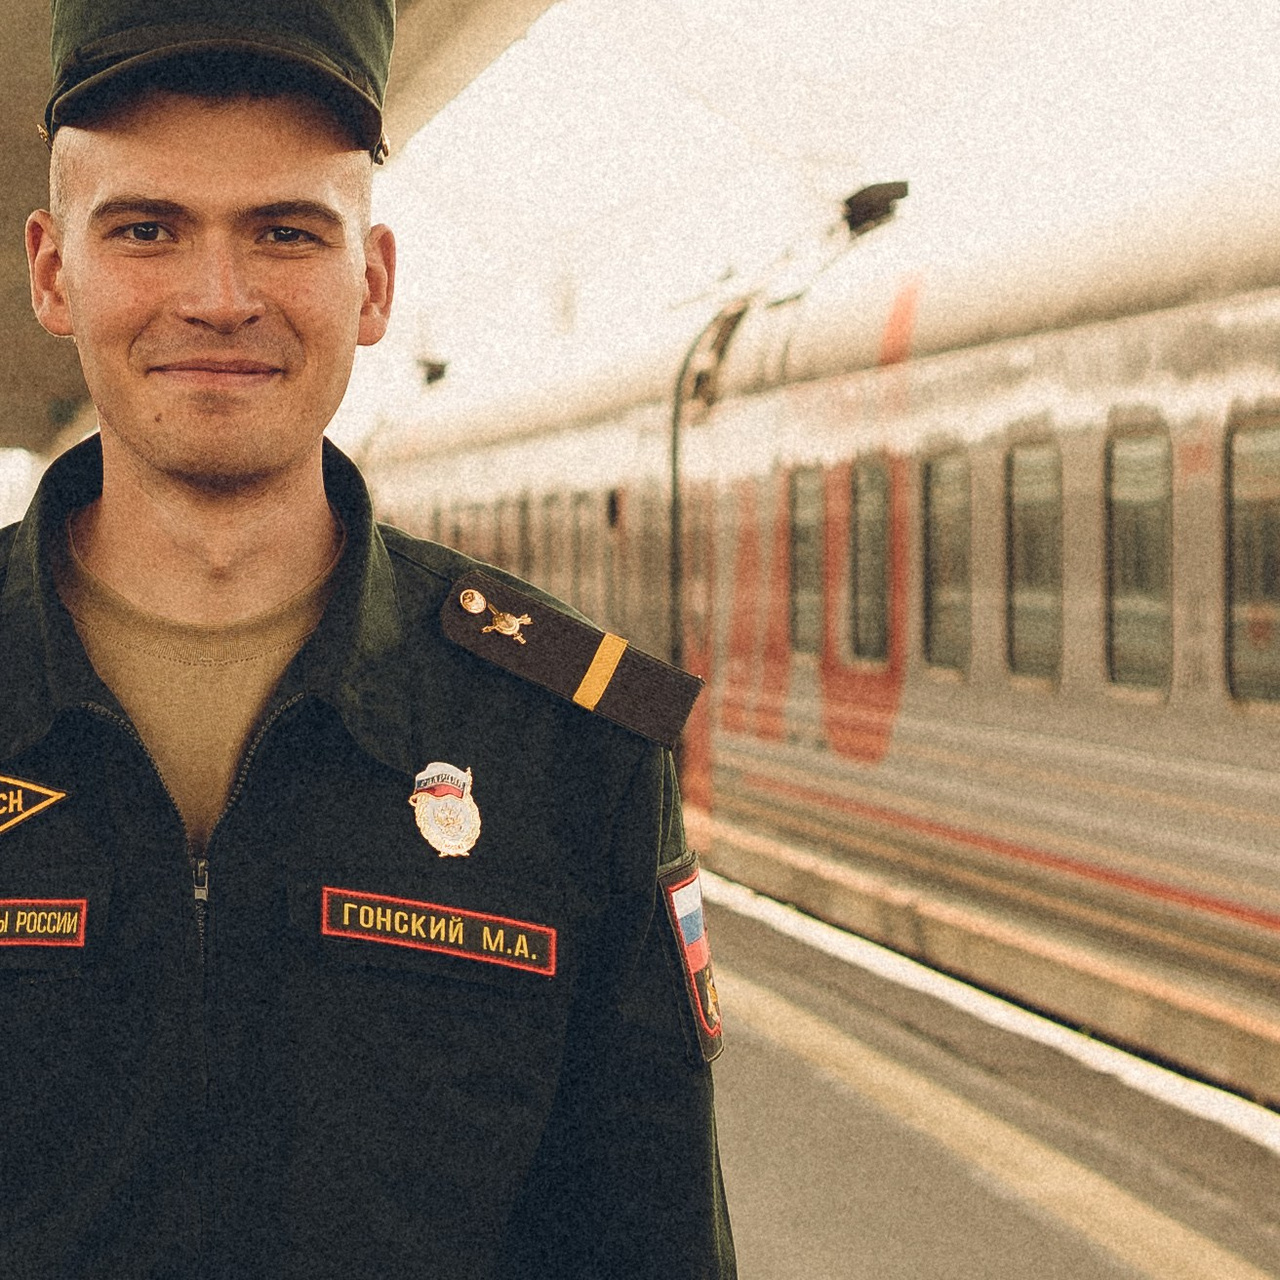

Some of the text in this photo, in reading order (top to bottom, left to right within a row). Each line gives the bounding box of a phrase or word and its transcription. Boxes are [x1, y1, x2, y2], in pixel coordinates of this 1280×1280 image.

[15, 911, 78, 934] РОССИИ
[343, 903, 538, 960] ГОНСКИЙ М.А.
